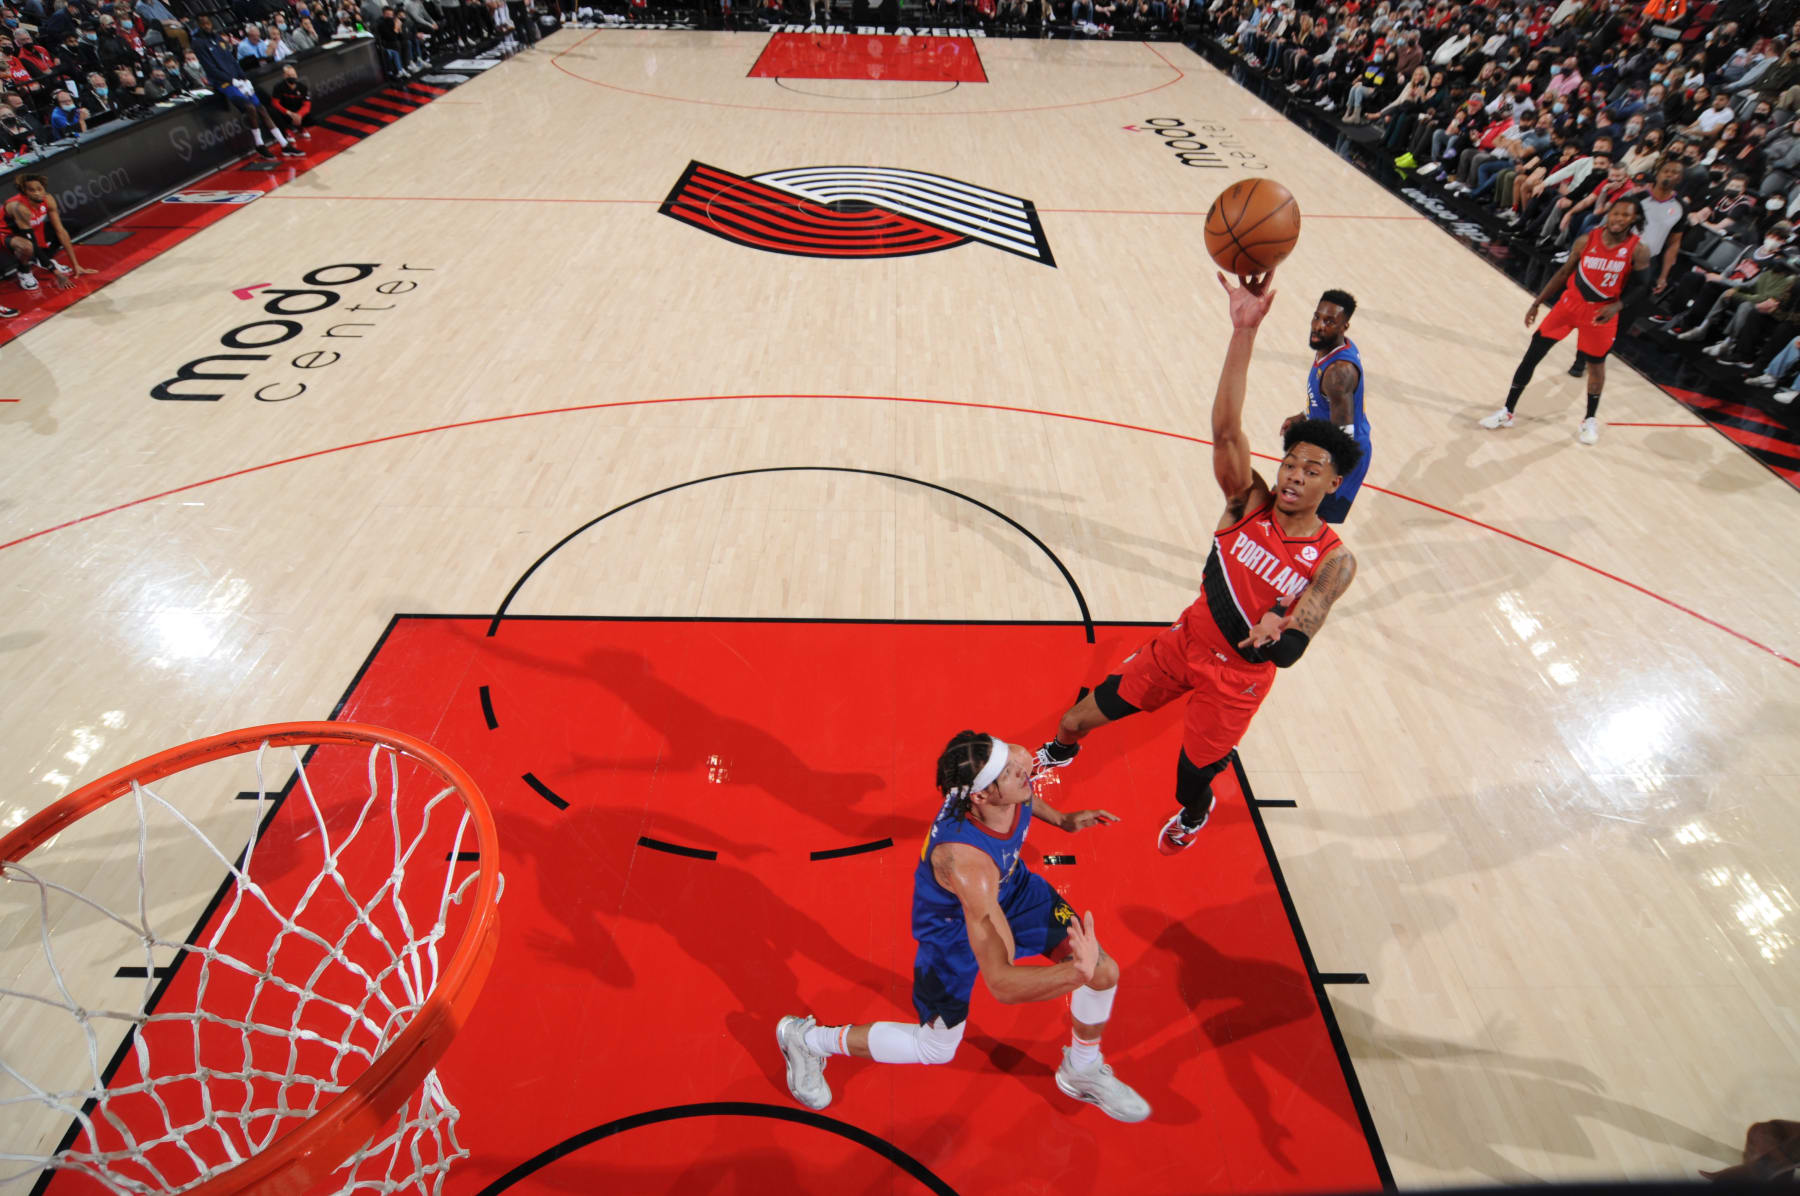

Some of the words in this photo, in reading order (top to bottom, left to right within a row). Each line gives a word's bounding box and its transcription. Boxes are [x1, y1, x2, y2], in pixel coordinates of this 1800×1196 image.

[767, 23, 850, 34] TRAIL
[855, 26, 987, 37] BLAZERS
[1140, 117, 1230, 169] moda
[1190, 118, 1268, 170] center
[56, 168, 131, 213] ios.com
[1583, 255, 1626, 273] PORTLAND
[1600, 272, 1620, 287] 23
[150, 263, 382, 402] moda
[254, 263, 435, 402] center
